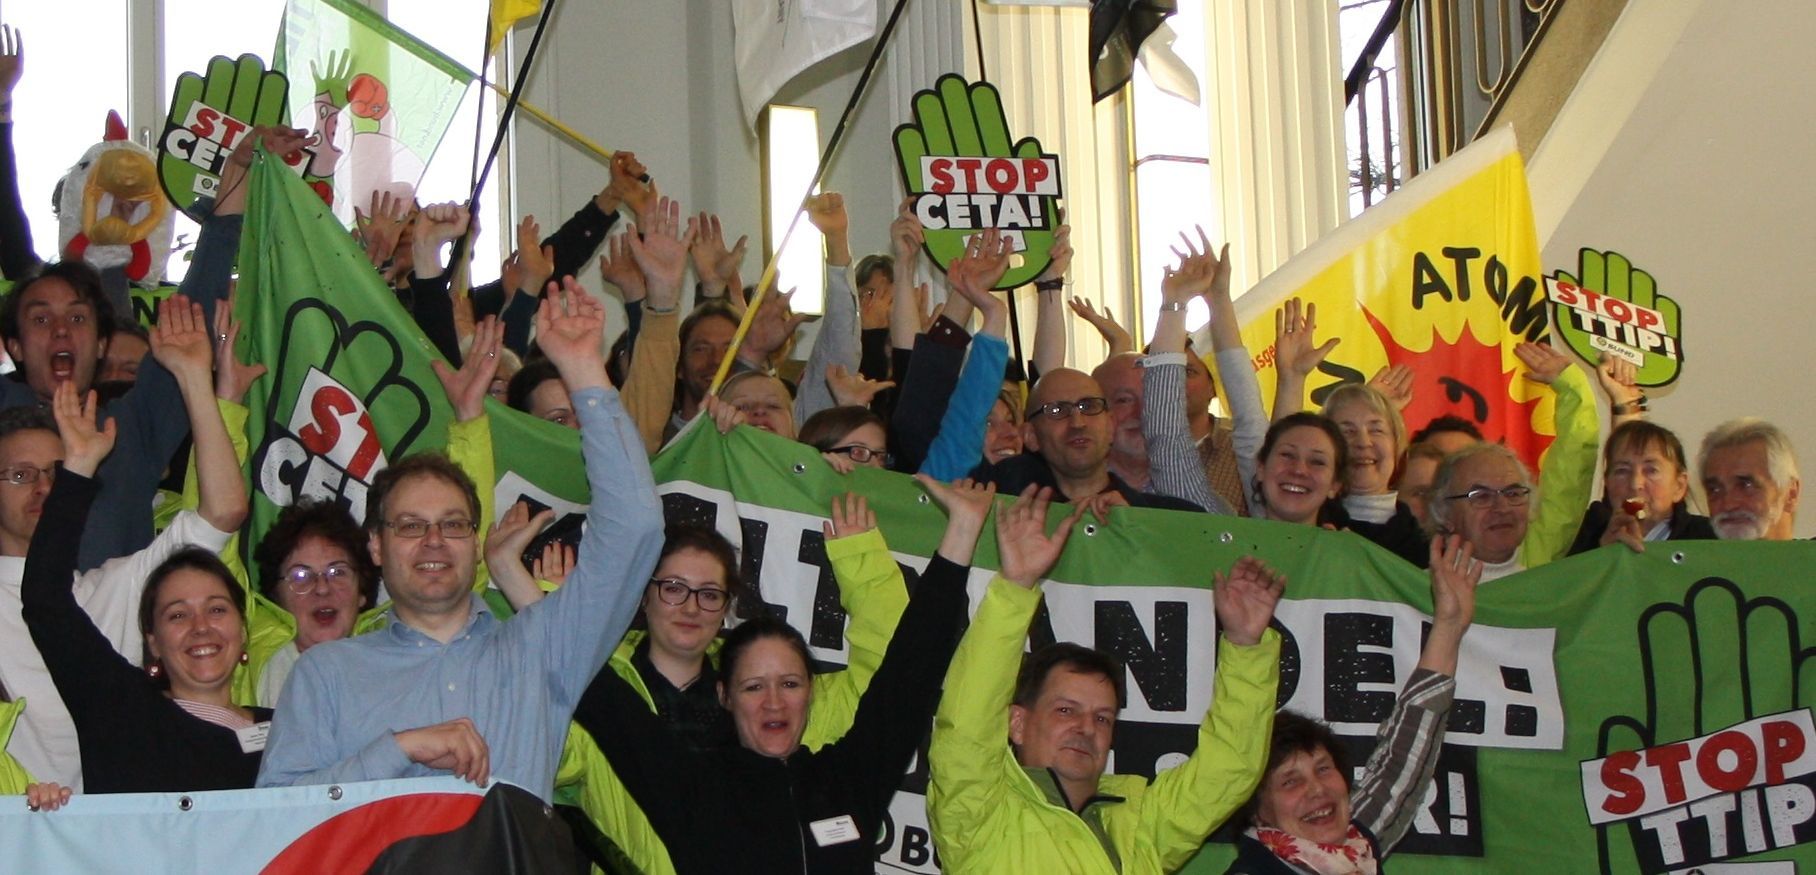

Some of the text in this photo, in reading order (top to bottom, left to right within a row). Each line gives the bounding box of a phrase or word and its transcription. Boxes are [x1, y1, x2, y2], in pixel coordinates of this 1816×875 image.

[929, 158, 1049, 194] STOP
[916, 194, 1043, 230] CETA!
[1411, 246, 1551, 346] ATOM
[1556, 281, 1658, 329] STOP
[1573, 308, 1677, 360] TTIP!
[1607, 343, 1635, 359] BUND
[1601, 720, 1806, 815] STOP
